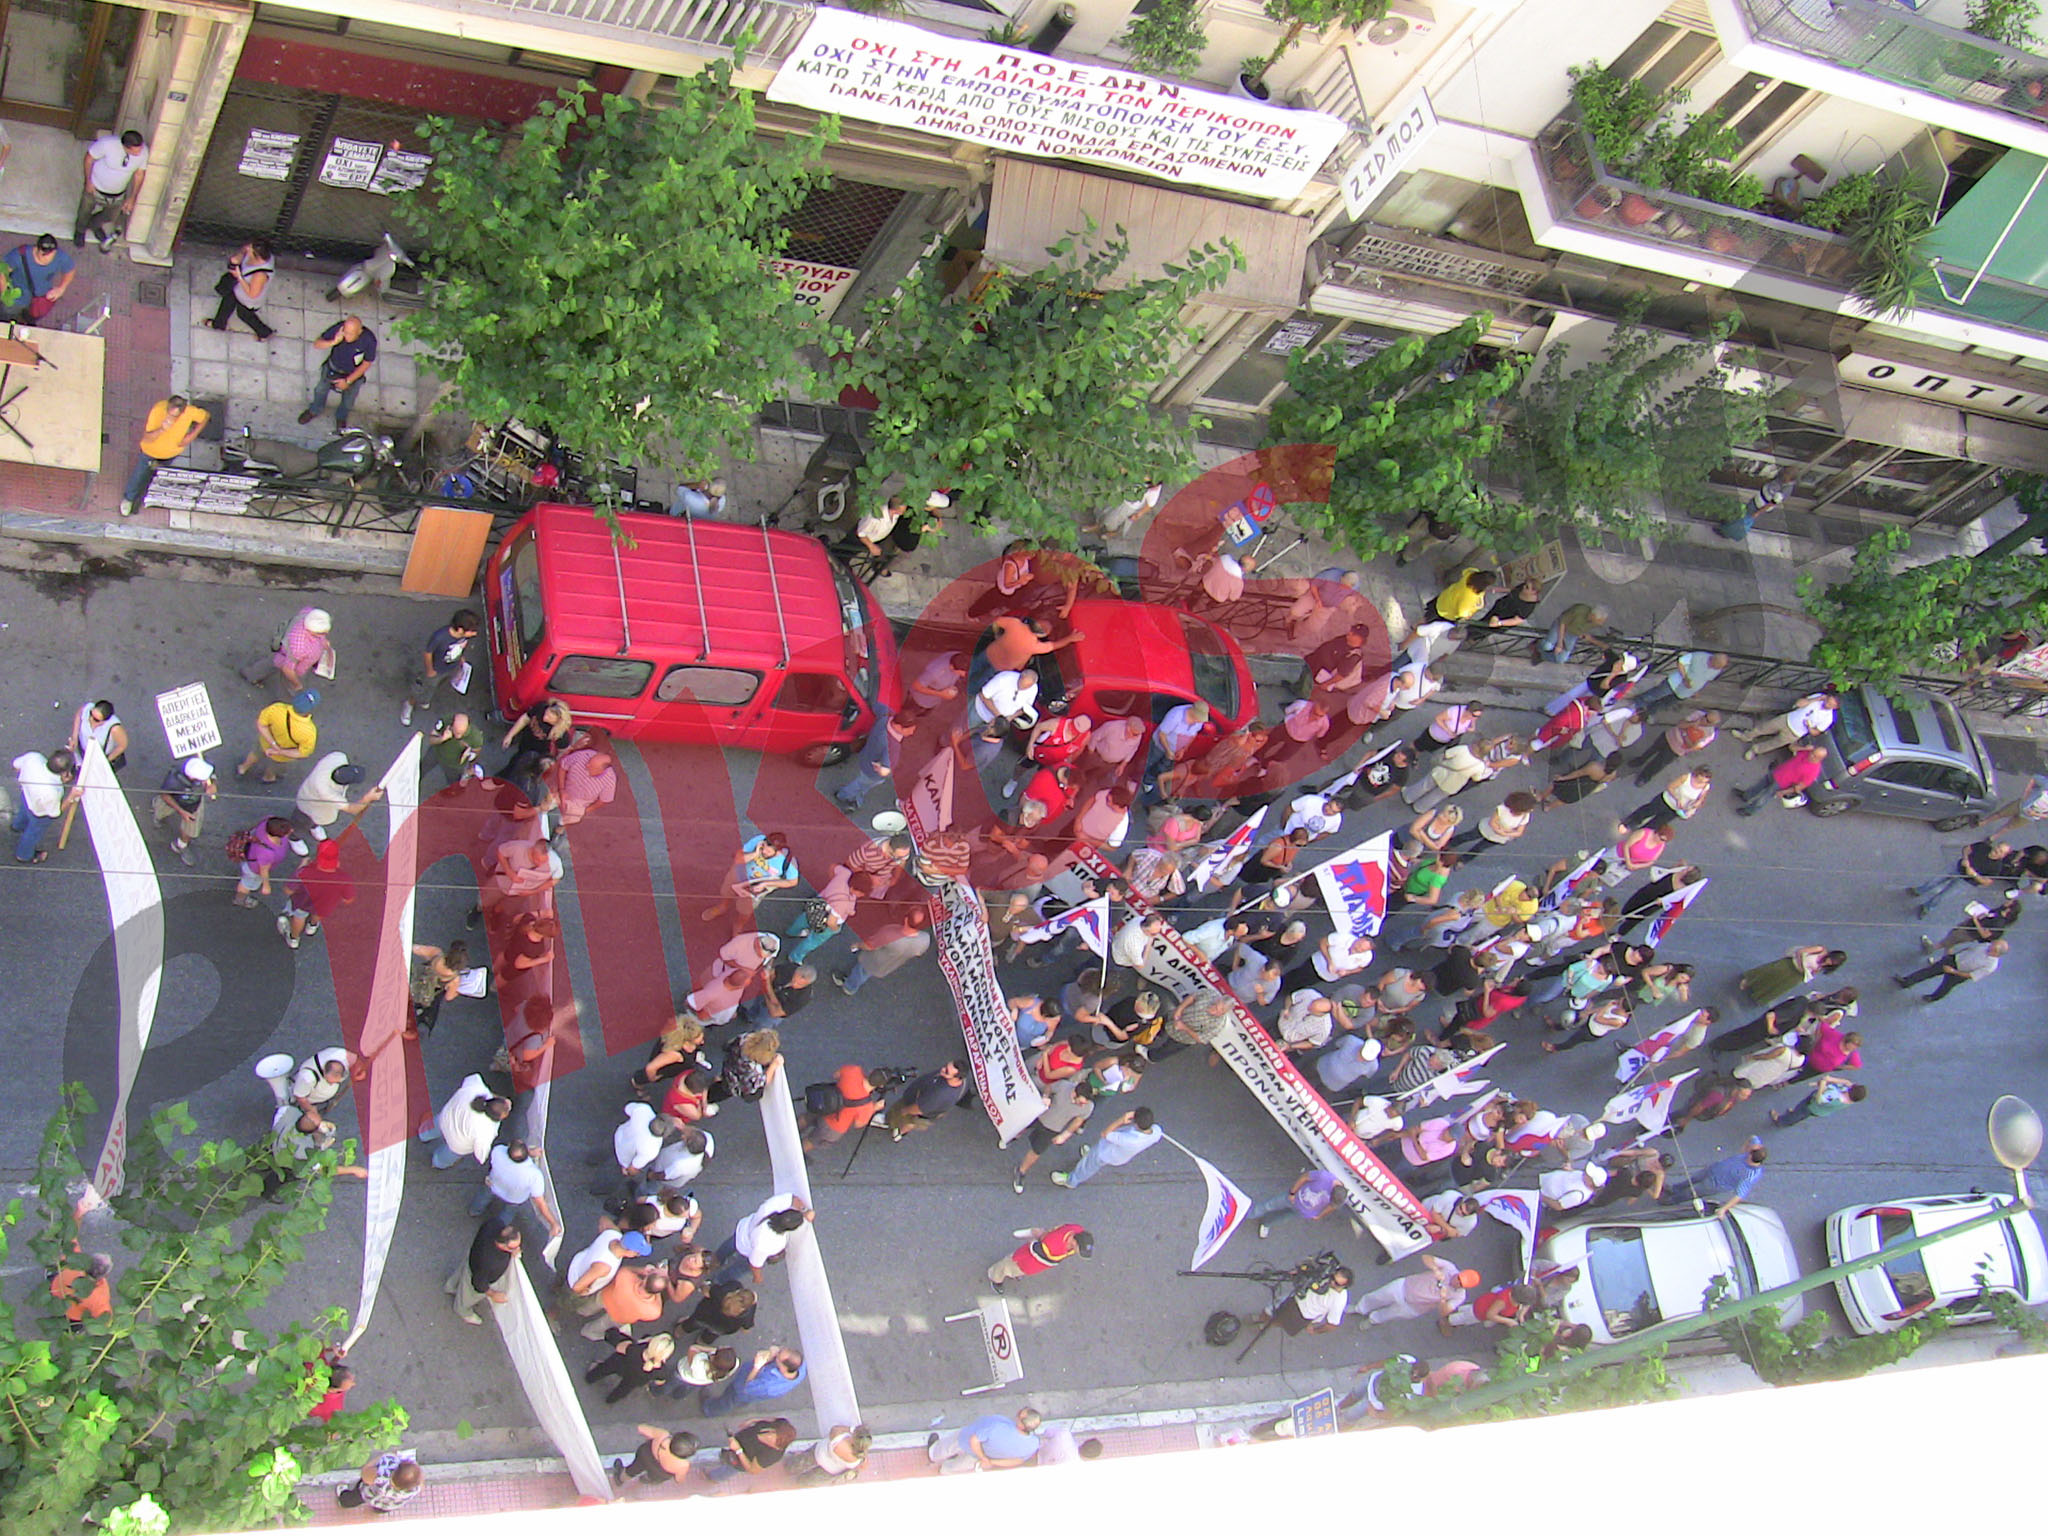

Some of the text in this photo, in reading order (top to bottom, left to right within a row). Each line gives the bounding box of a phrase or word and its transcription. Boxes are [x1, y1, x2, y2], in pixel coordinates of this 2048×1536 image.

[796, 59, 1311, 172] ΚΑΤΩ ΤΑ ΧΕΡΙΑ ΑΠΟ ΤΟΥΣ ΜΙΣΘΟΥΣ ΚΑΙ ΤΙΣ ΣΥΝΤΑΞΕΙΣ
[813, 44, 854, 64] ΟΧΙ
[866, 58, 929, 84] ΣΤΗΝ
[941, 74, 1194, 134] ΕΜΠΟΡΕΥΜΑΤΟΠΟΙΗΣΗ
[1206, 126, 1248, 142] ΤΟΥ
[829, 82, 1268, 178] ΠΑΝΕΛΛΗΝΙΑ ΟΜΟΣΠΟΝΔΙΑ ΕΡΓΑΖΟΜΕΝΩΝ
[851, 37, 1298, 140] ΟΧΙ ΣΤΗ ΛΑΙΛΑΠΑ ΤΩΝ ΠΕΡΙΚΟΠΩΝ
[914, 116, 1184, 177] ΔΗΜΟΣΙΩΝ ΝΟΣΟΚΟΜΕΙΩΝ
[162, 692, 205, 716] ΑΠΕΡΓΙΕΣ
[165, 704, 209, 728] ΔΙΑΡΚΕΙΑΣ
[176, 720, 208, 738] ΜΕΧΡΙ
[187, 730, 217, 750] ΝΙΚΗ
[959, 979, 992, 1063] ΚΑΝΕΝΑΣ
[969, 938, 1011, 1054] ΣΥΓΧΩΝΕΥΘΕΙ
[994, 1002, 1014, 1036] ΥΓΕΙΑ
[1078, 844, 1107, 873] ΟΧΙ
[1339, 1139, 1428, 1226] ΝΟΣΟΚΟΜΕΙΩ
[964, 1025, 1002, 1124] ΠΑΡΑΡΤΗΜΑΤΟΣ
[991, 1043, 1016, 1105] ΥΓΕΙΑΣ
[1221, 1040, 1300, 1133] ΠΡΟΝΟΙΑΣ
[1237, 1030, 1284, 1092] ΔΩΡΕΑΝ
[1392, 1212, 1423, 1242] ΛΑΟ
